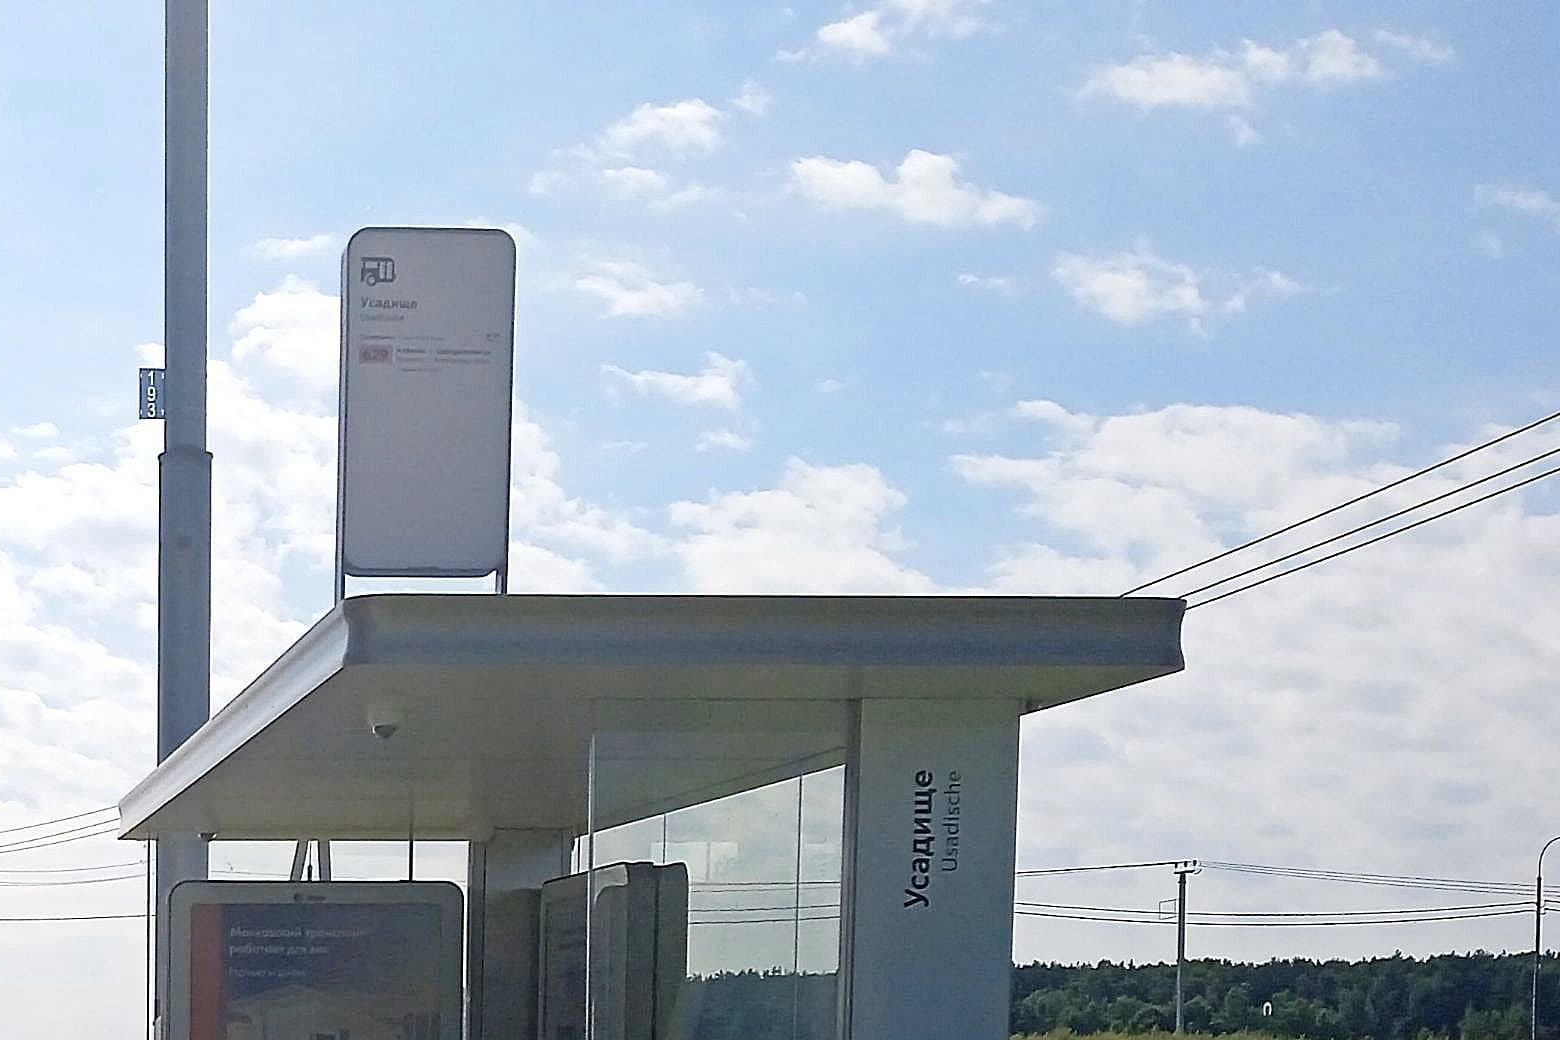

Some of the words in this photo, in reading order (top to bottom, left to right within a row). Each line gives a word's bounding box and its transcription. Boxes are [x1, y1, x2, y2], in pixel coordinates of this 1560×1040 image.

[360, 296, 418, 309] Усадище
[147, 370, 156, 418] 193
[904, 769, 937, 908] Усадище
[941, 769, 962, 872] Usadische
